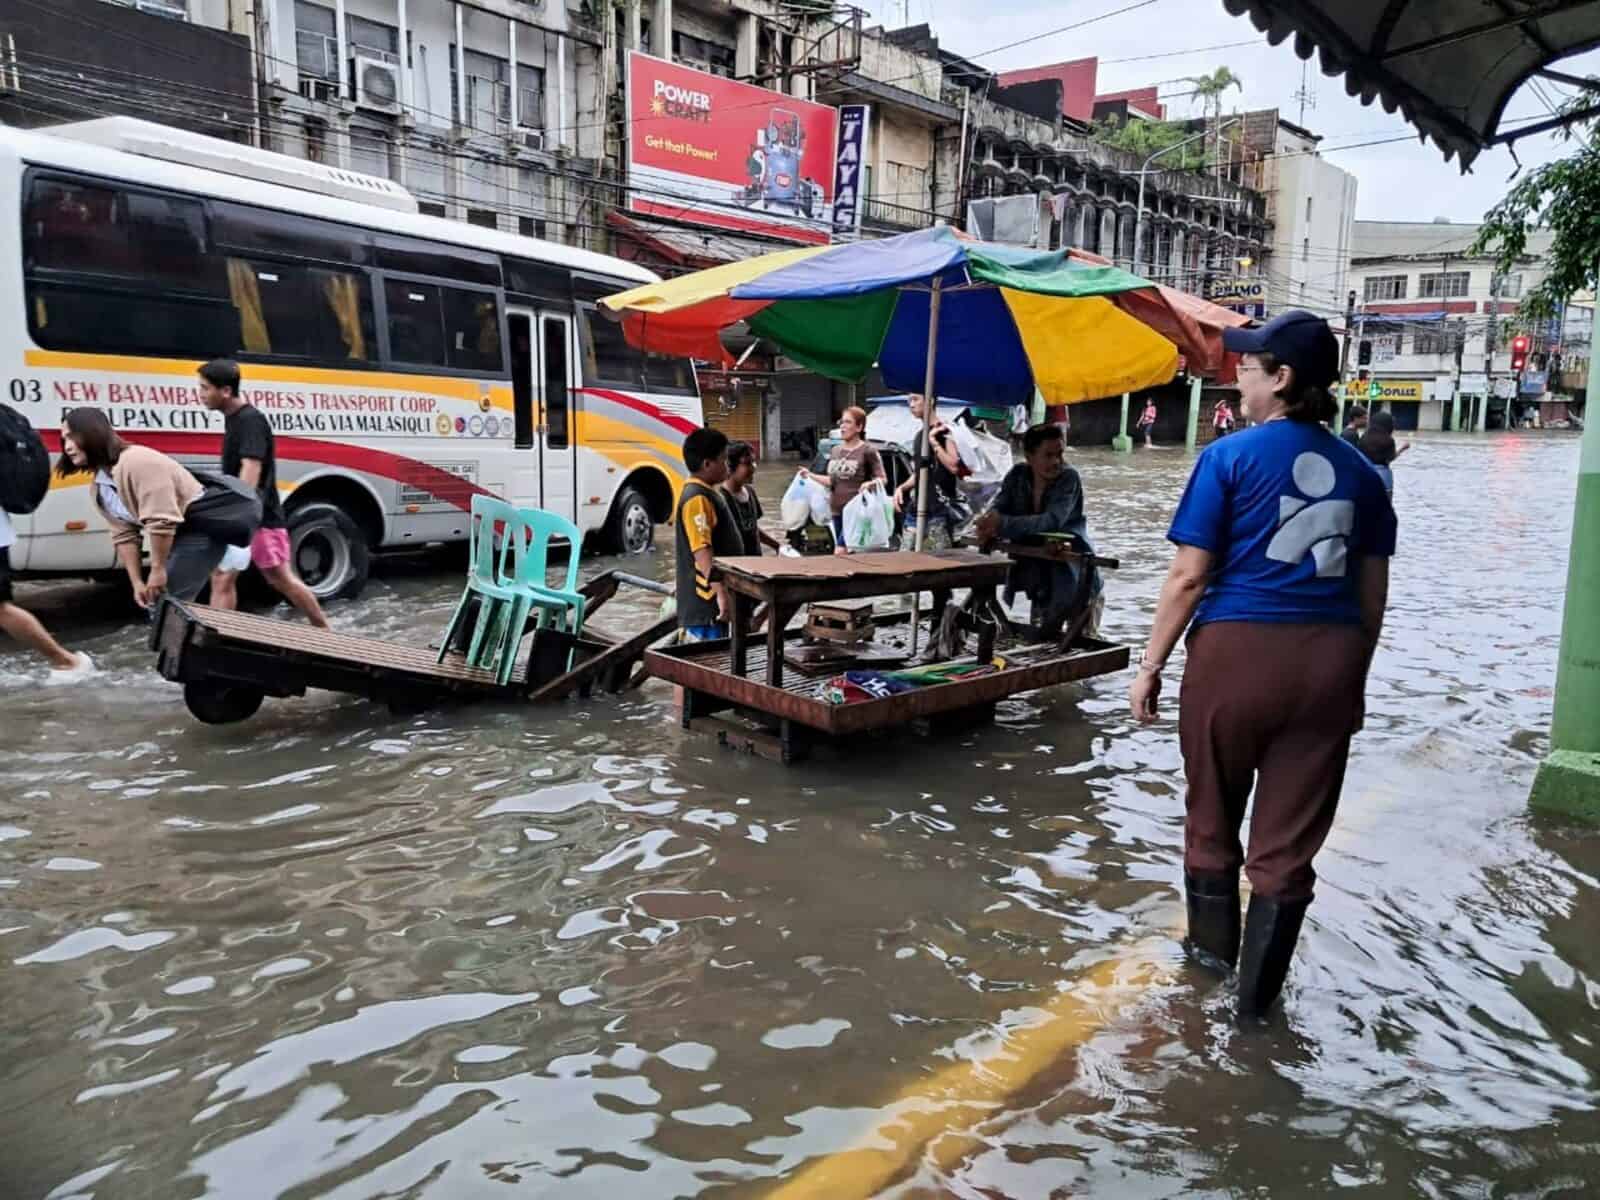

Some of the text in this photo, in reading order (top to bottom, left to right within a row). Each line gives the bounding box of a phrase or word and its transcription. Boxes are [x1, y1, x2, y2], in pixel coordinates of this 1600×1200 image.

[653, 79, 710, 110] POWER
[645, 134, 718, 160] Get that Power!
[10, 378, 42, 402] 03
[54, 381, 98, 401] NEW
[311, 393, 395, 412] TRANSPORT
[400, 396, 441, 414] CORP.
[169, 409, 209, 429] CITY
[328, 414, 354, 431] VIA
[356, 415, 431, 434] MALASIQUI
